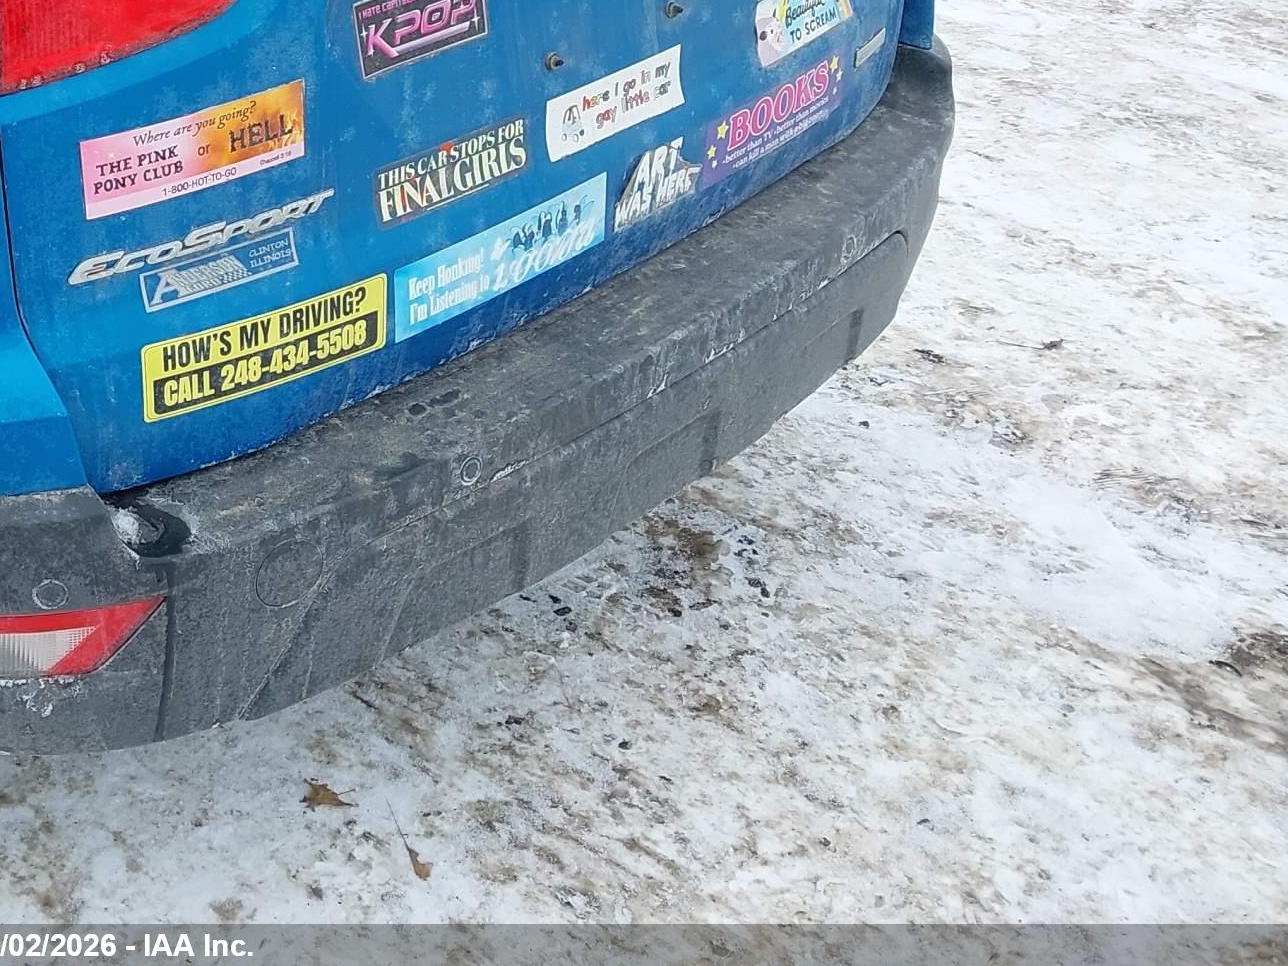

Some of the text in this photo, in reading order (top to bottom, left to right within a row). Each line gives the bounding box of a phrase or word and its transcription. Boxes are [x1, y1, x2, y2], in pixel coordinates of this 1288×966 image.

[790, 7, 837, 43] TO SCREAM
[582, 89, 610, 112] here
[623, 78, 637, 95] go
[640, 69, 651, 85] in
[655, 61, 671, 79] my
[727, 60, 829, 151] BOOKS
[132, 100, 257, 147] Where are you going?
[596, 105, 617, 130] gay
[621, 89, 650, 113] little
[197, 143, 211, 157] or
[228, 113, 294, 153] HELL
[378, 118, 524, 190] THIS CAR STOPS FOR
[747, 138, 763, 151] than
[93, 160, 184, 195] PONY CLUB
[95, 144, 179, 177] THE PINK
[163, 166, 237, 197] 1-800-HOT-TO-GO
[378, 136, 527, 223] FINAL GIRLS
[614, 166, 702, 233] WAS HERE
[248, 238, 289, 258] CLINTON
[250, 249, 292, 269] ILLINOIS
[408, 247, 484, 301] Keep Honking!
[409, 273, 490, 326] I'm Listening to
[162, 286, 367, 372] HOW'S MY DRIVING?
[163, 319, 367, 408] CALL 248-434-5508
